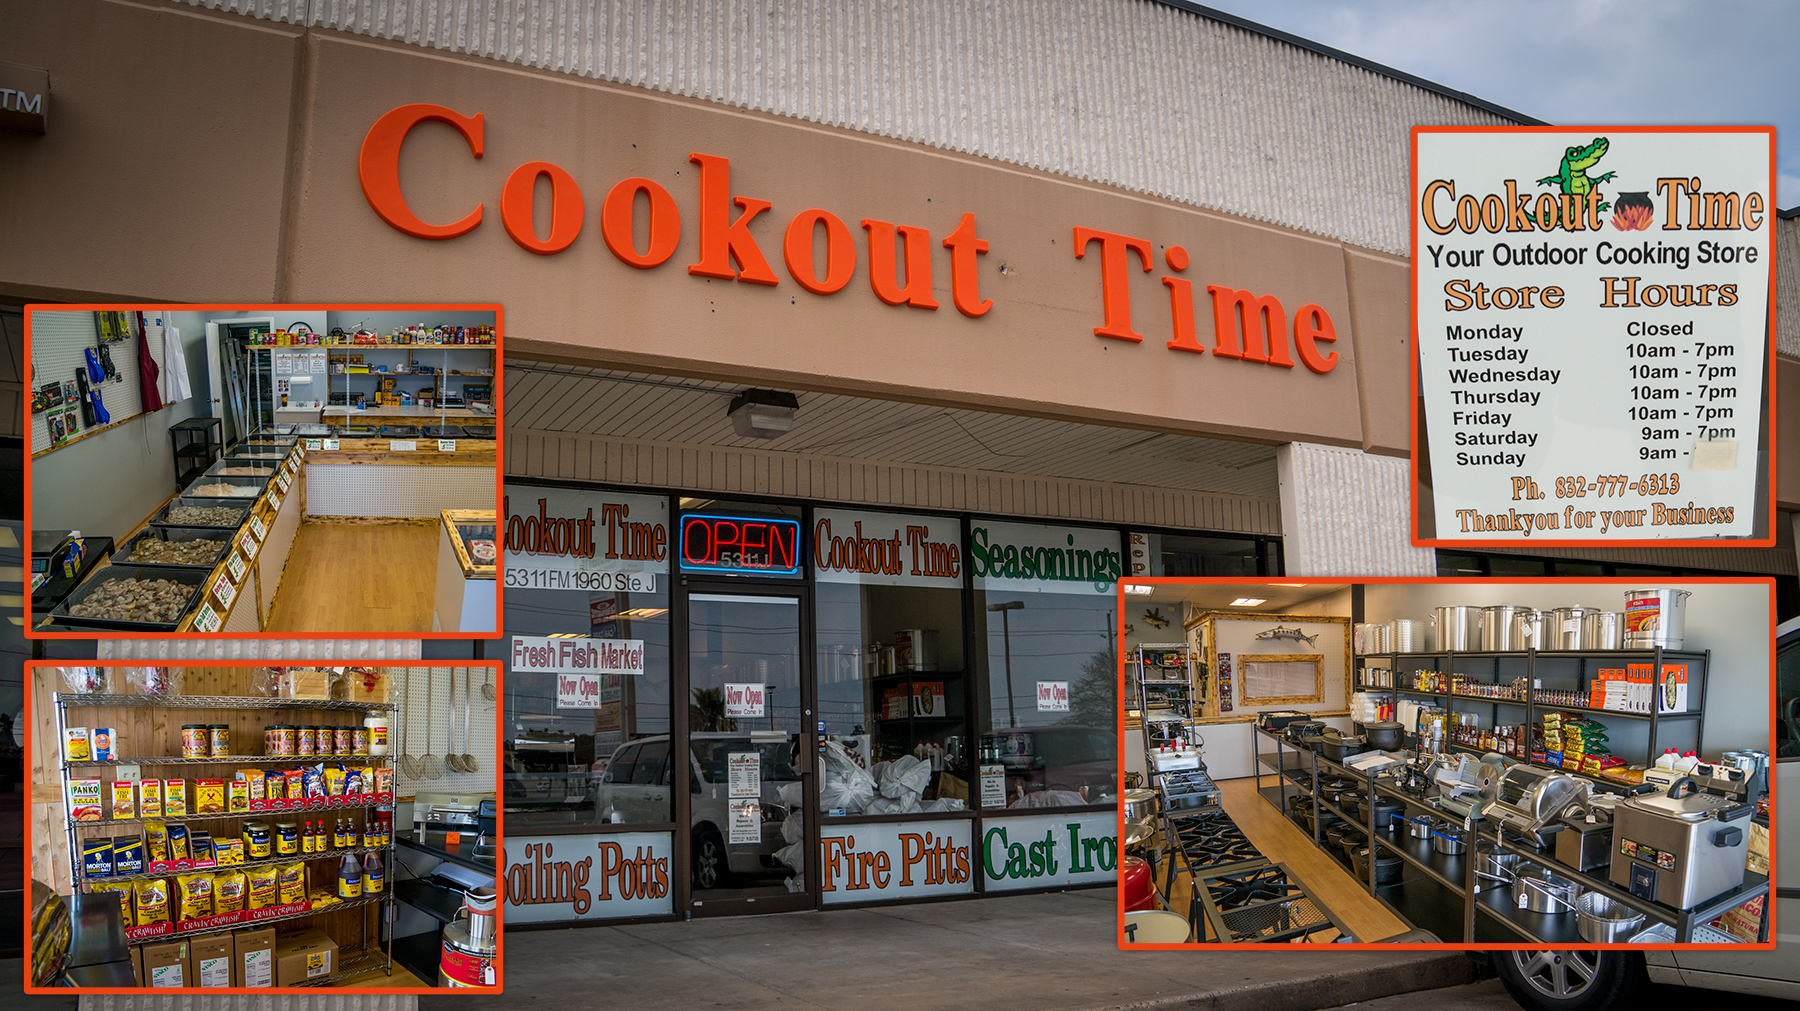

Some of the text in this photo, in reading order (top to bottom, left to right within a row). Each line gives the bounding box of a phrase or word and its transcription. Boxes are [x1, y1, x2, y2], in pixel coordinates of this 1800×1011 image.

[1422, 177, 1764, 235] Cookout Time
[359, 103, 1340, 375] Cookout Time
[1427, 241, 1758, 269] Your Outdoor Cooking Store
[1444, 277, 1739, 311] Store Hours
[1446, 321, 1694, 343] Monday Closed
[1448, 346, 1529, 364] Tuesday
[1626, 344, 1676, 358] 10am
[1694, 343, 1735, 361] 7pm
[1449, 367, 1561, 385] Wednesday
[1629, 365, 1679, 379] 10am
[1697, 364, 1737, 381] 7pm
[1451, 389, 1541, 407] Thursday
[1630, 386, 1680, 400] 10am
[1698, 385, 1737, 402] 7pm
[1453, 411, 1512, 428] Friday
[1628, 406, 1677, 421] 10am
[1695, 405, 1734, 423] 7pm
[1455, 431, 1538, 448] Saturday
[1641, 427, 1679, 441] 9am
[1697, 426, 1736, 442] 7pm
[1456, 451, 1526, 469] Sunday
[1639, 447, 1677, 461] 9am
[1511, 473, 1681, 500] Ph. 832-777-6313
[503, 496, 666, 562] ookout Time
[1456, 501, 1735, 536] Thankyou for your Business
[684, 520, 795, 569] OPEN
[815, 518, 960, 578] Cookout Time
[1130, 534, 1146, 575] Rep
[971, 527, 1121, 593] Seasonings
[615, 572, 642, 592] Ste
[646, 574, 655, 592] J
[512, 639, 642, 669] Fresh Fish Market
[559, 676, 577, 695] Now
[580, 676, 598, 700] Open
[727, 686, 762, 709] Now Open
[1038, 684, 1051, 700] Now
[73, 786, 98, 794] PANKO
[821, 831, 970, 892] Fire Pitts
[983, 823, 1117, 881] Cast Iro
[503, 841, 668, 914] oiling Potts
